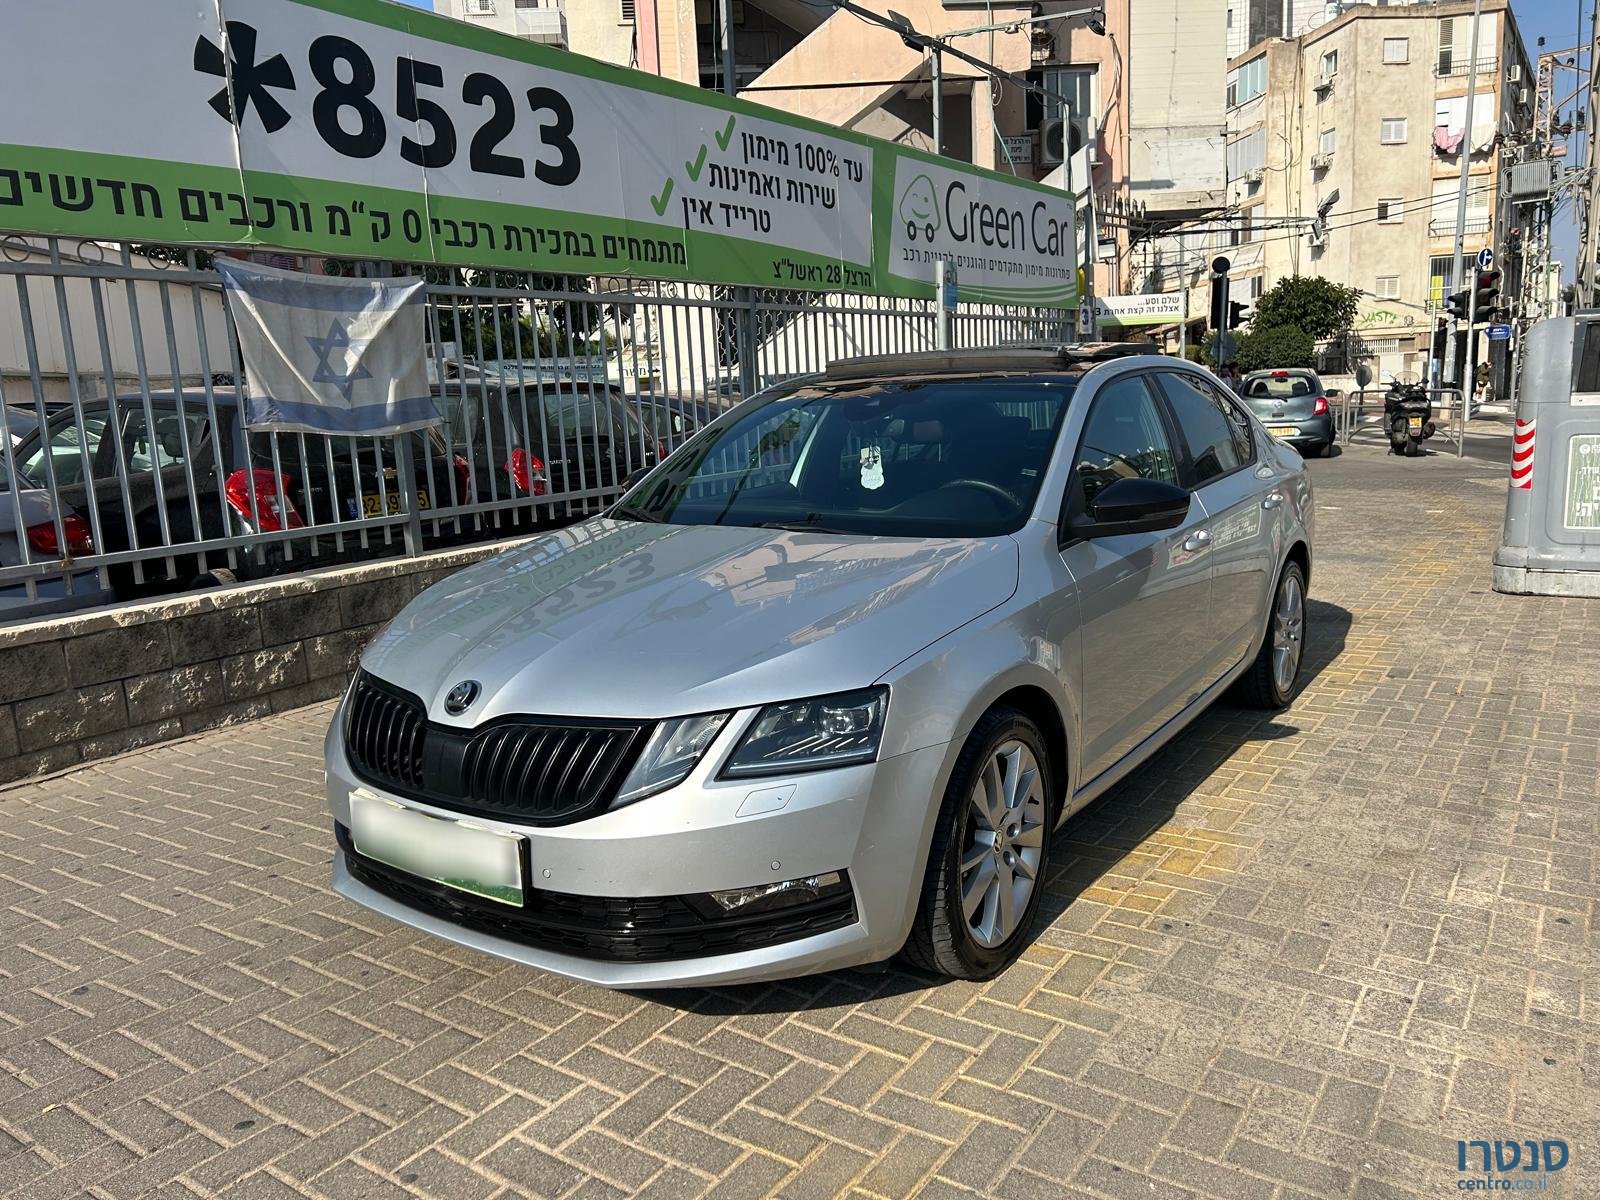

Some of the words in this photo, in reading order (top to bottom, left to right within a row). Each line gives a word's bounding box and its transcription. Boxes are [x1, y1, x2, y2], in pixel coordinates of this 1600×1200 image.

[741, 132, 789, 166] מימון
[795, 142, 840, 178] 100%
[709, 163, 782, 199] ואמינות
[843, 158, 863, 183] עד
[786, 179, 836, 209] שירות
[177, 187, 313, 233] ורכבים
[681, 197, 714, 230] אין
[719, 202, 771, 233] טרייד
[945, 181, 1025, 251] Green
[1031, 201, 1068, 257] Car
[431, 217, 496, 250] רכבי
[503, 225, 597, 257] במכירת
[602, 235, 687, 265] מתמחים
[903, 247, 921, 263] רכב
[825, 264, 841, 284] 28
[844, 265, 872, 287] הרצל
[1025, 263, 1044, 279] מימון
